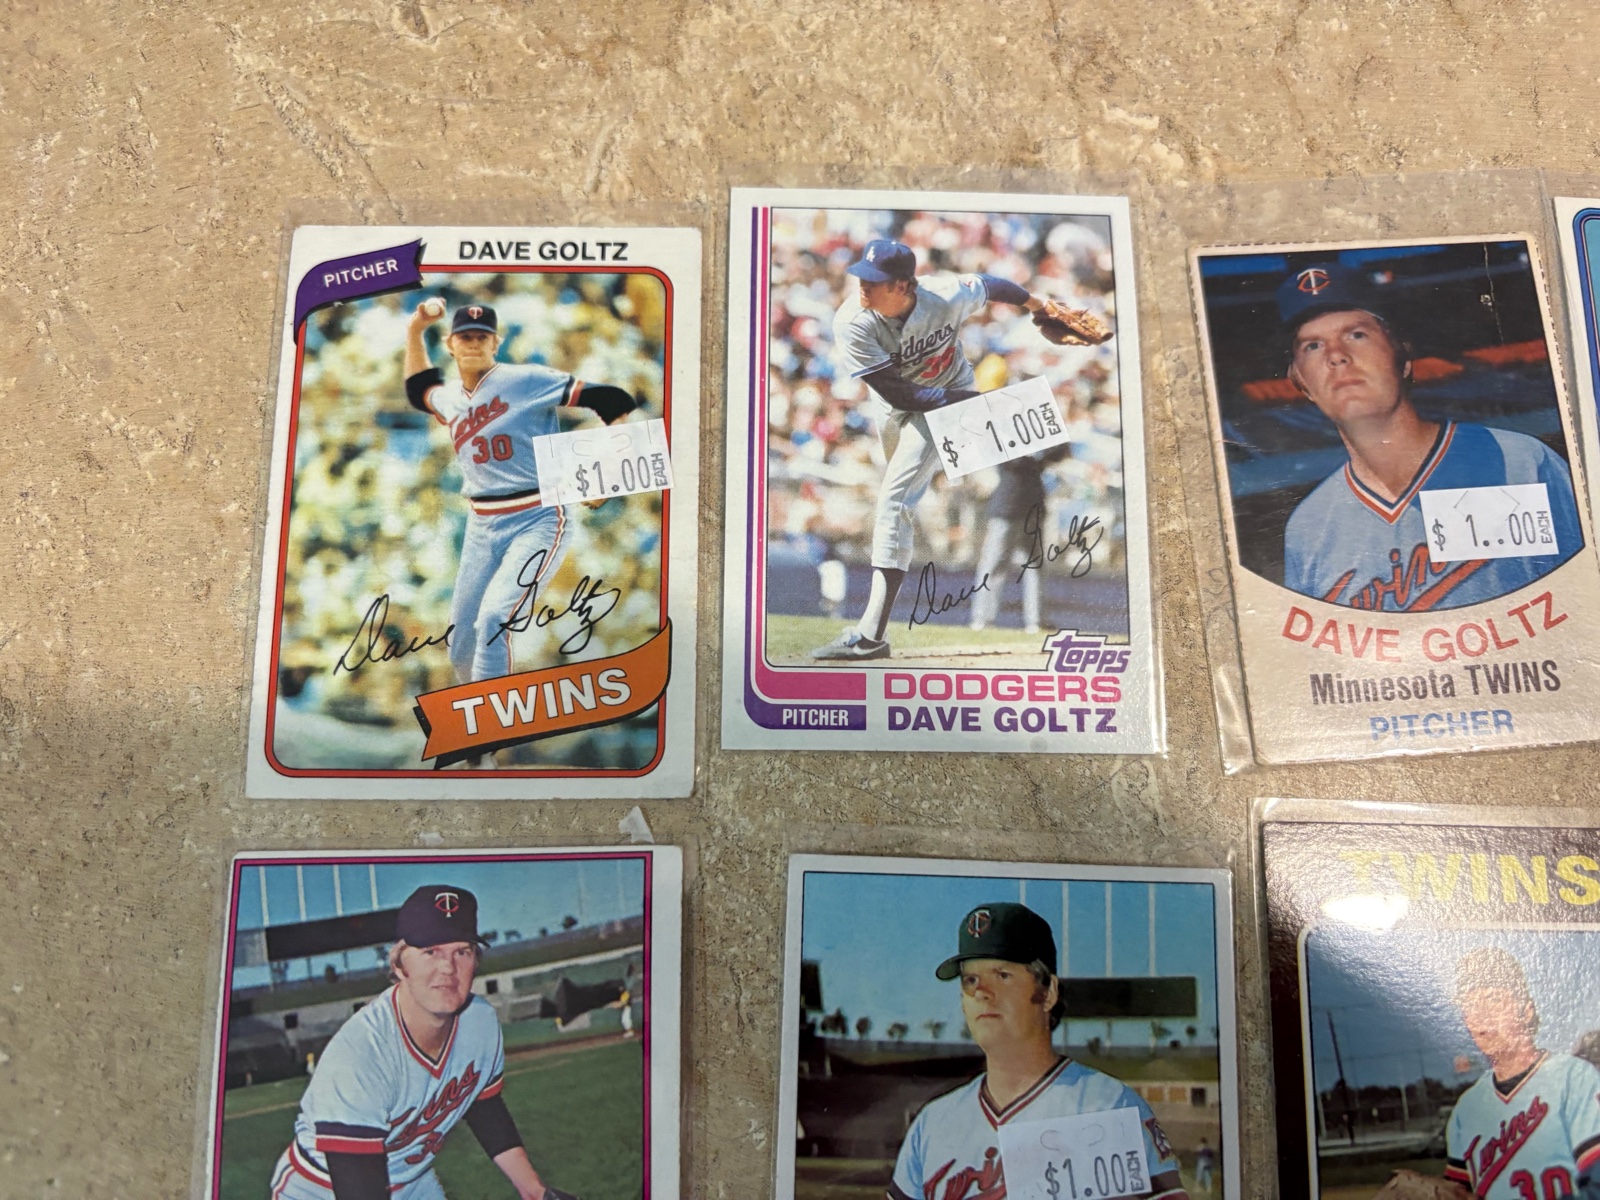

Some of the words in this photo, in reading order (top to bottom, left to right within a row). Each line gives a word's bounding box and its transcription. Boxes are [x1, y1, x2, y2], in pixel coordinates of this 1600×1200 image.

[458, 241, 531, 260] DAVE
[538, 242, 629, 261] GOLTZ
[323, 259, 399, 288] PITCHER
[889, 323, 955, 366] odgers
[1039, 402, 1062, 436] EACH
[471, 434, 514, 465] 30
[575, 456, 651, 497] $1.00
[651, 452, 669, 487] EACH
[1536, 510, 1554, 545] EACH
[1281, 606, 1401, 662] DAVE
[1422, 591, 1568, 662] GOLTZ
[884, 673, 1122, 703] DODGERS
[1309, 673, 1456, 705] Minnesota
[1463, 659, 1561, 696] TWINS
[452, 667, 632, 735] TWINS
[782, 708, 849, 727] PITCHER
[888, 706, 982, 732] DAVE
[993, 707, 1118, 733] GOLTZ
[1370, 709, 1515, 741] PITCHER
[1338, 850, 1600, 906] TWINS
[1463, 1095, 1549, 1198] Twins
[1044, 1153, 1126, 1200] $1.00
[1126, 1150, 1145, 1192] EACH
